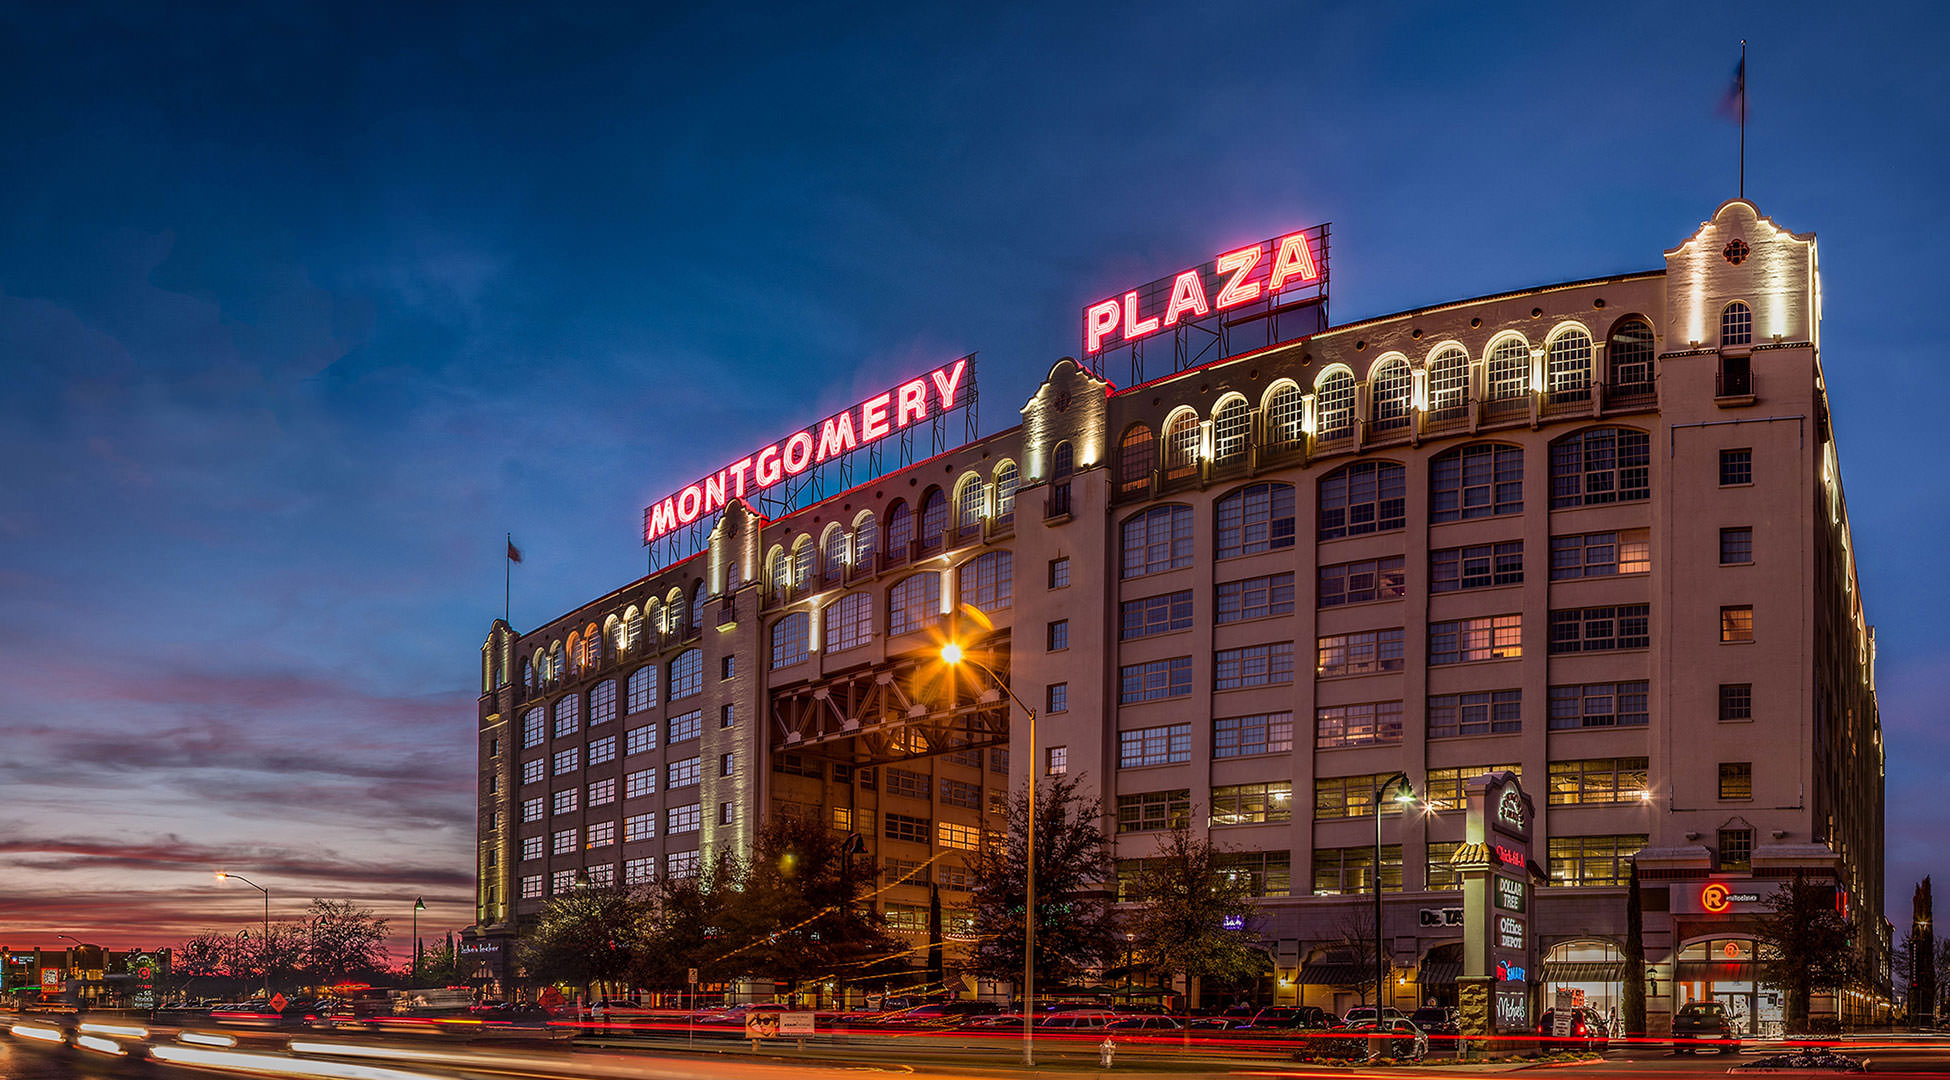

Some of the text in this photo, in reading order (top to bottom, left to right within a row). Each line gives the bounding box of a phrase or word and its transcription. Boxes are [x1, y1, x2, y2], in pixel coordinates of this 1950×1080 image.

[1087, 233, 1318, 353] PLAZA
[647, 359, 967, 541] MONTGOMERY
[1500, 878, 1522, 897] DOLLAR
[1503, 893, 1519, 910] TREE
[1442, 908, 1465, 926] TA
[1500, 917, 1522, 936] Office
[1502, 935, 1522, 949] DEPOT
[1496, 996, 1526, 1021] Michaels
